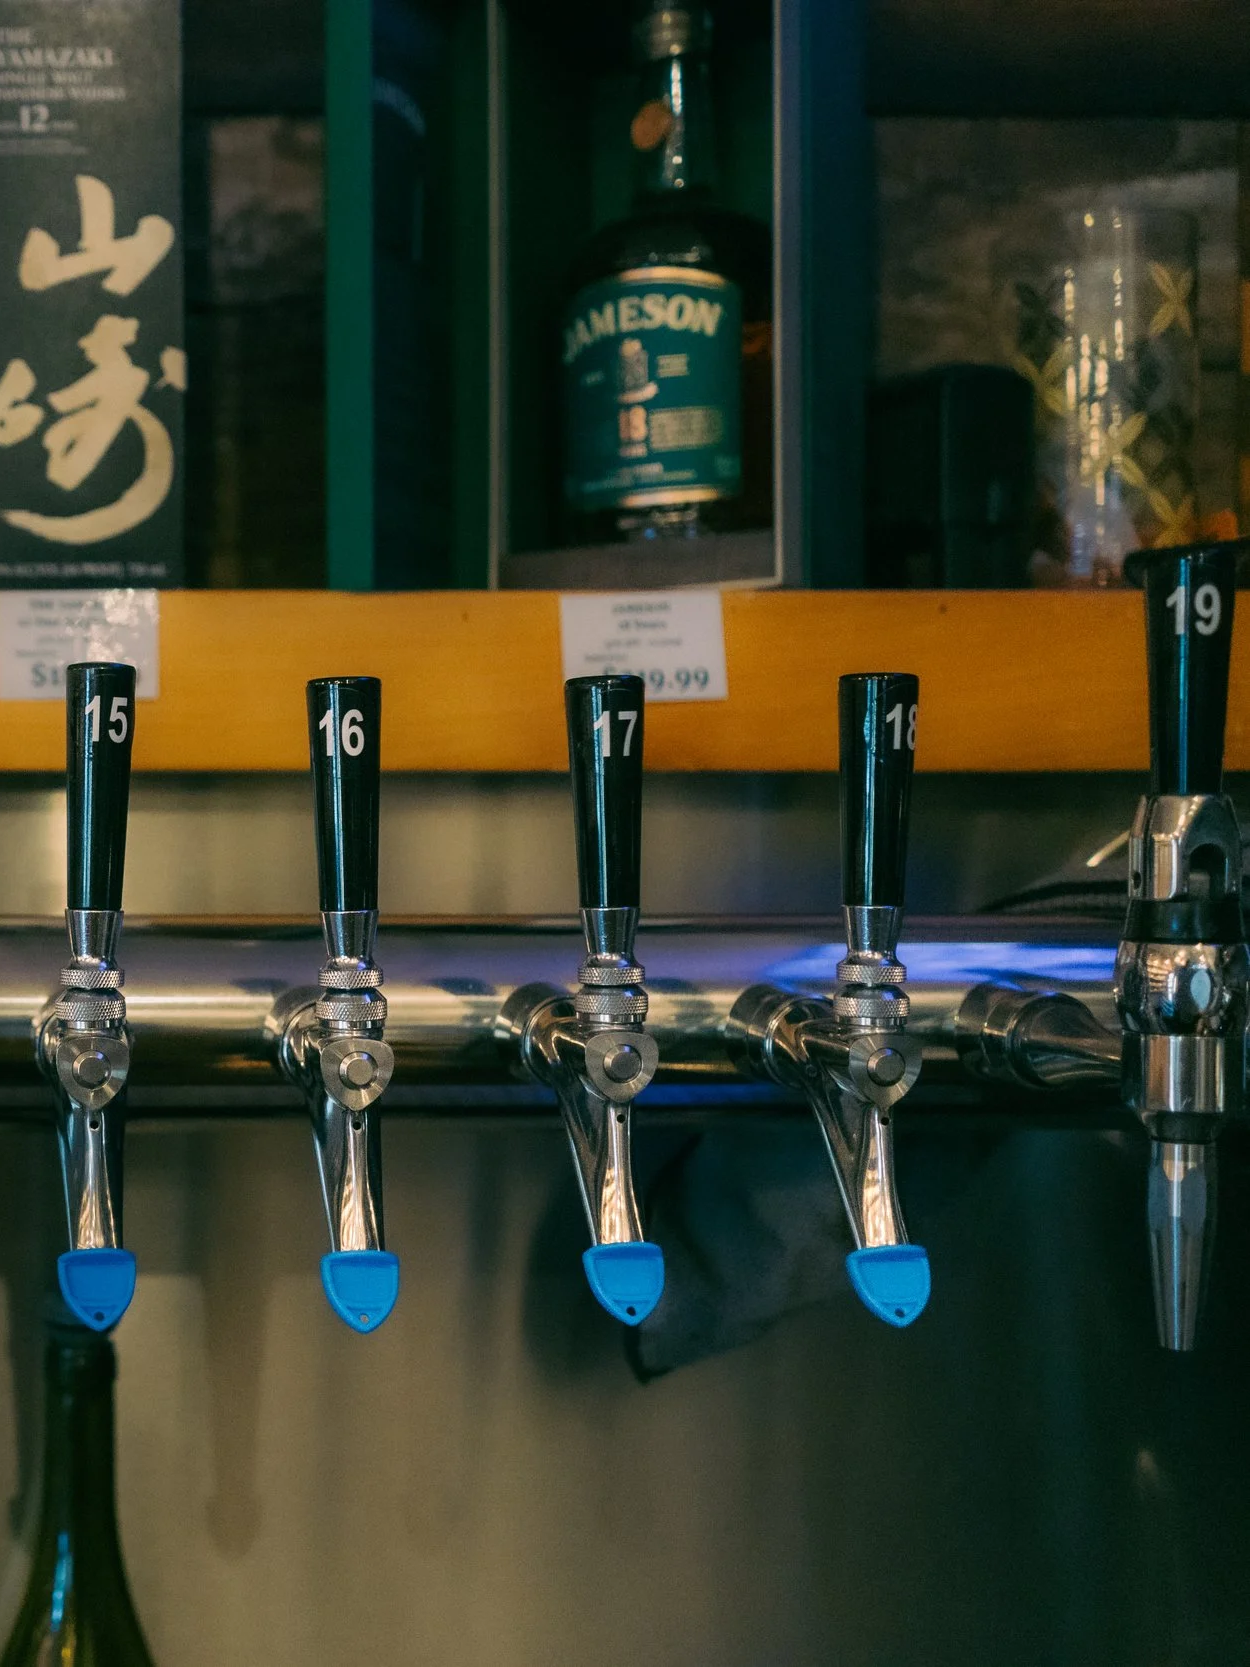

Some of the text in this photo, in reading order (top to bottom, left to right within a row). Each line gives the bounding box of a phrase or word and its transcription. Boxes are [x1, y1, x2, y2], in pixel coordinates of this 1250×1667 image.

[19, 104, 50, 132] 12
[563, 293, 723, 365] JAMESON
[1165, 584, 1221, 636] 19
[85, 695, 128, 743] 15
[319, 708, 365, 756] 16
[593, 710, 638, 757] 17
